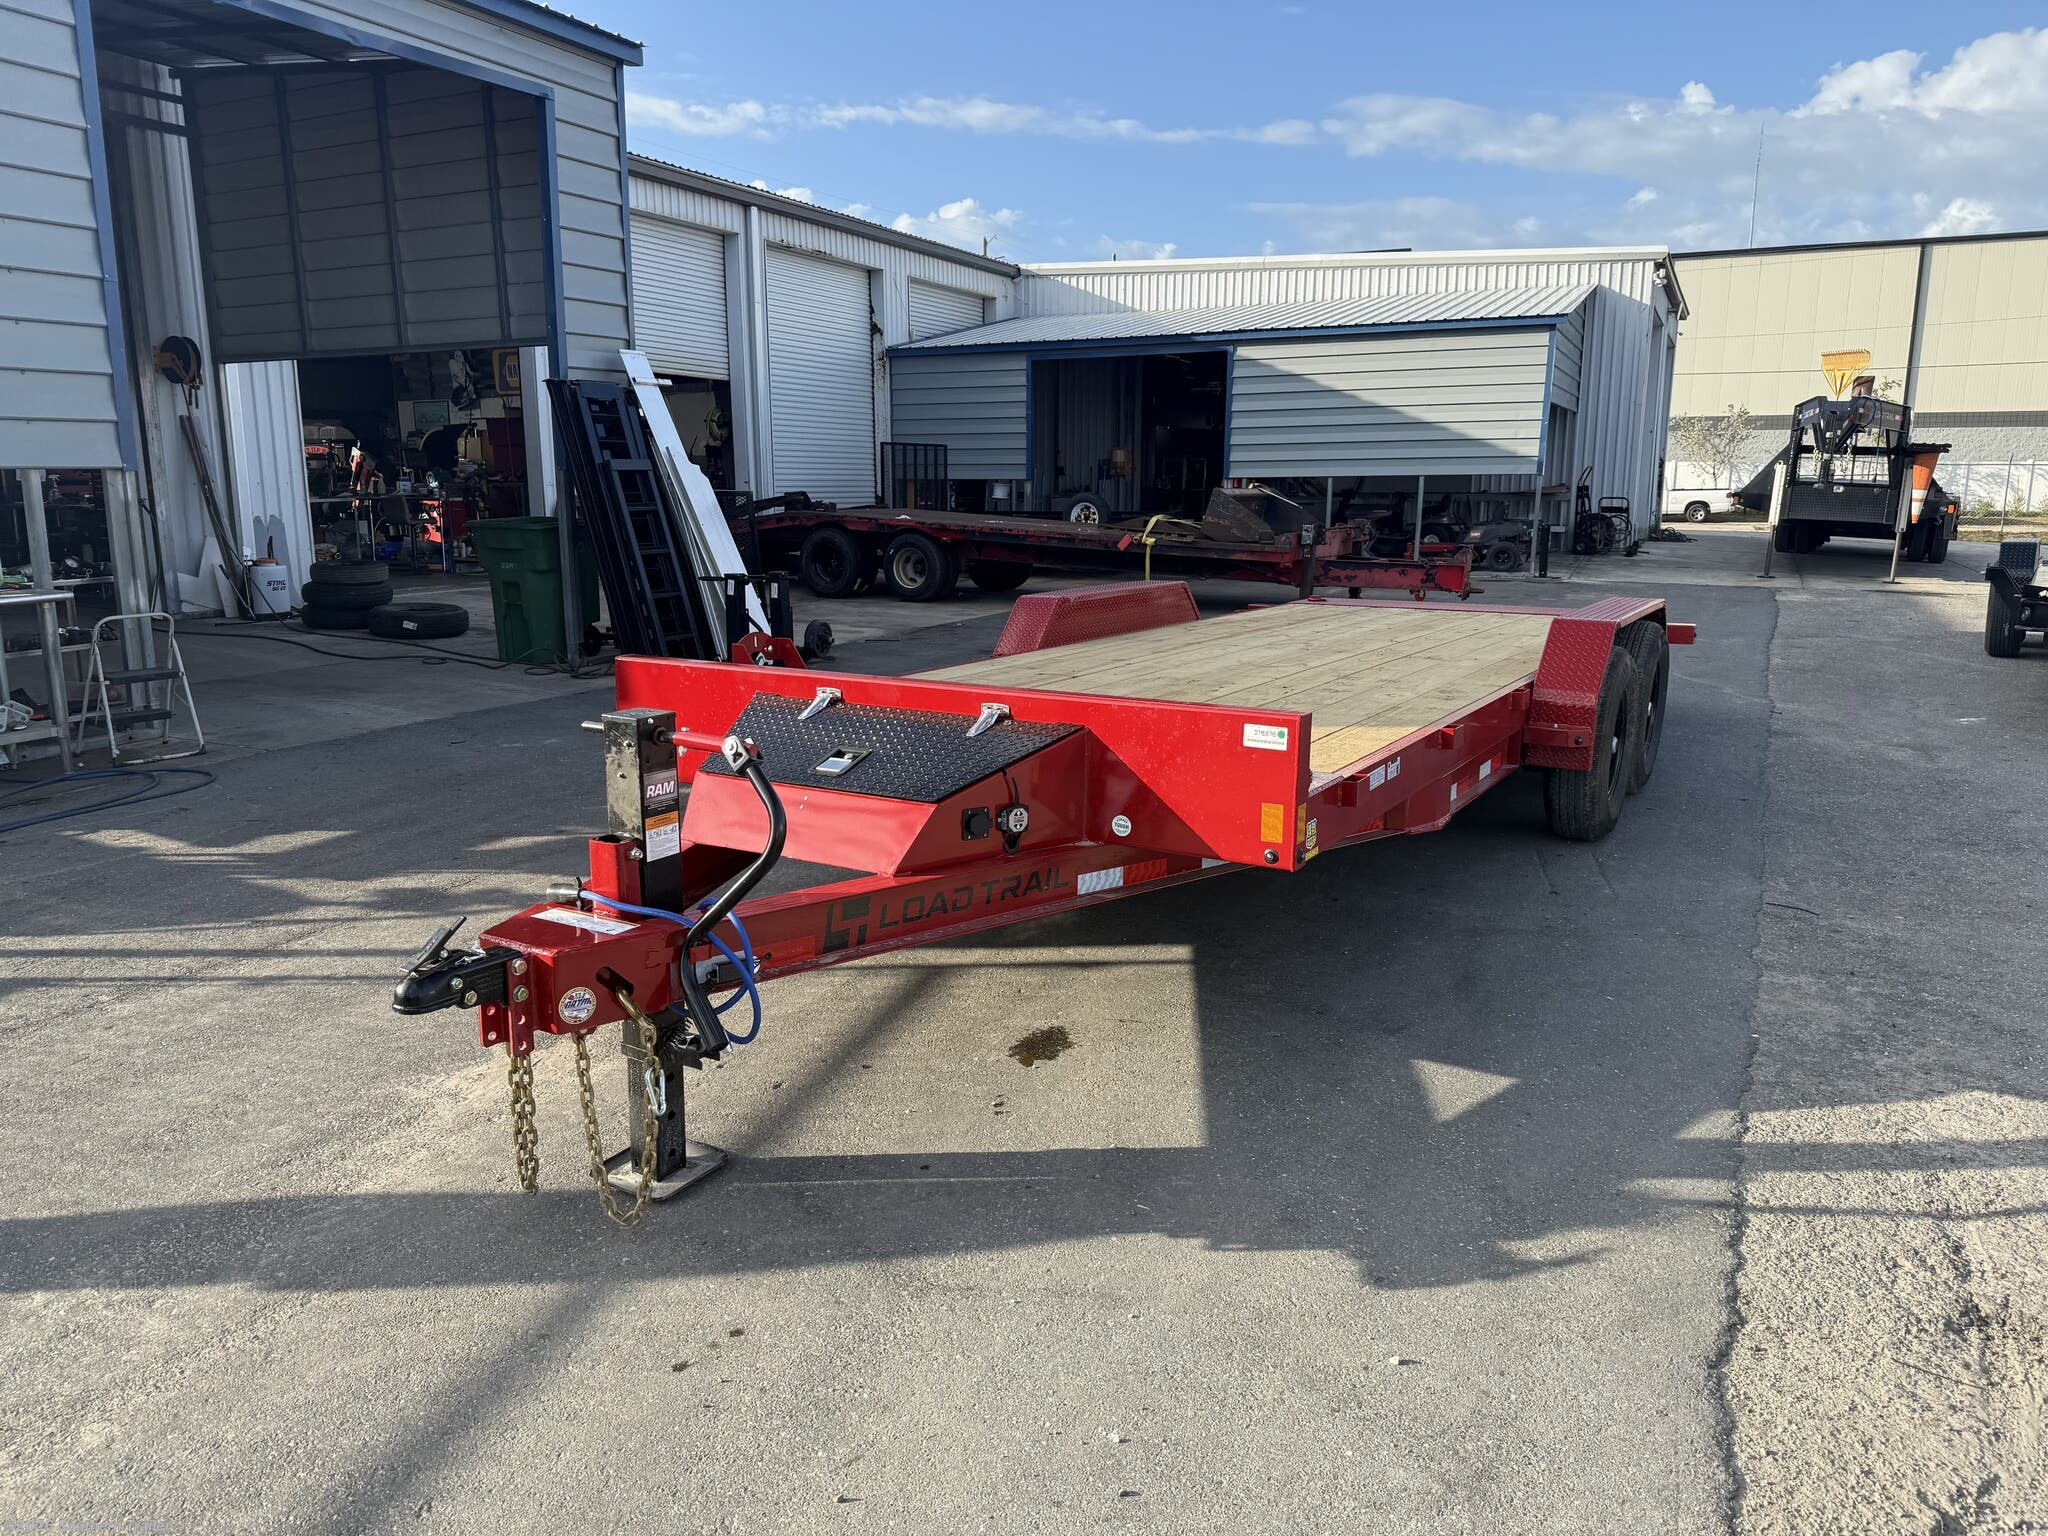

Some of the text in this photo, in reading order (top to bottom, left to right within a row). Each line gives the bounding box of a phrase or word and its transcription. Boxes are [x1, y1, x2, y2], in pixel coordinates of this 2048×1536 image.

[646, 780, 675, 799] RAM
[879, 886, 974, 929] LOAD
[981, 866, 1070, 905] TRAIL
